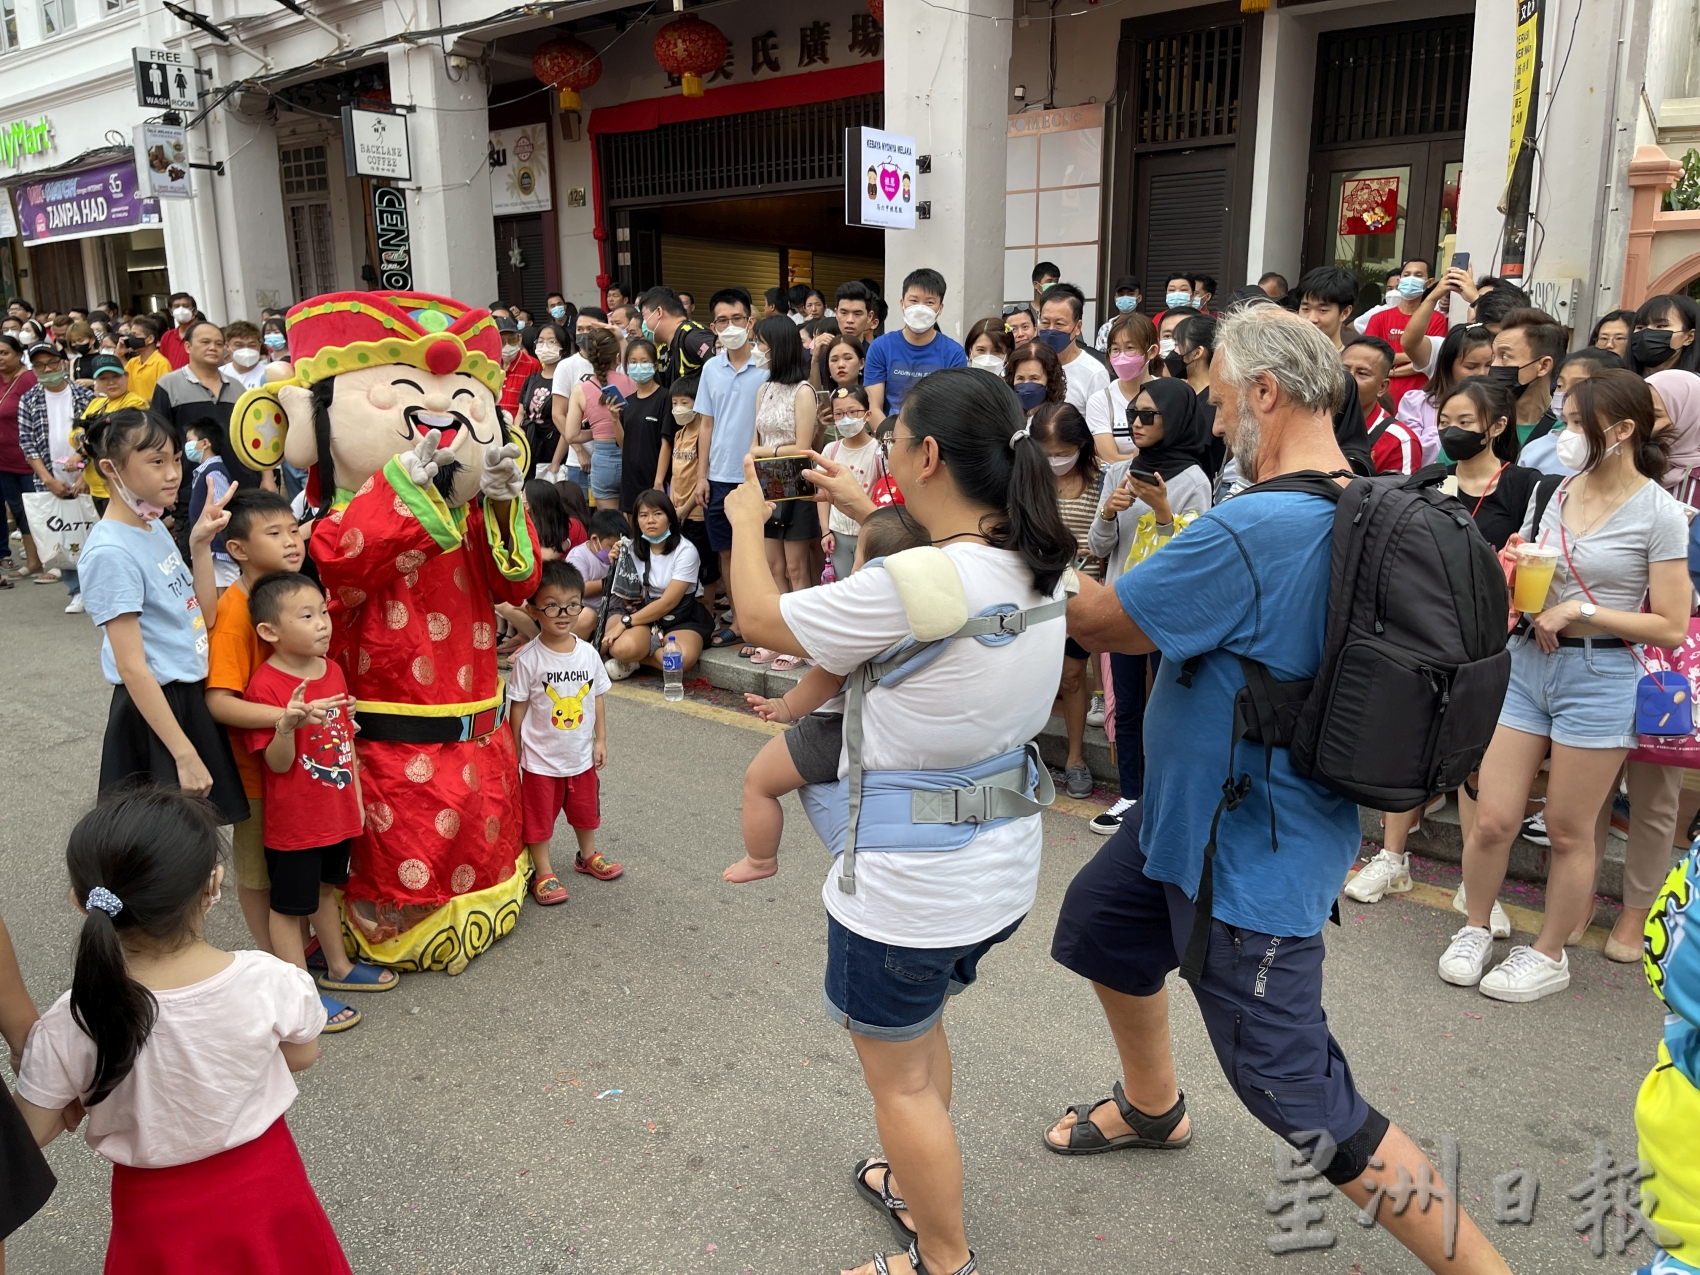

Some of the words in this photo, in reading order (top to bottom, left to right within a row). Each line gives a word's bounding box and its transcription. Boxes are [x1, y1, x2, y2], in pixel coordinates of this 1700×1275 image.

[150, 50, 181, 63] FREE
[146, 96, 170, 106] WASH
[171, 99, 195, 107] ROOM
[360, 143, 402, 157] BACKLANE
[866, 139, 881, 151] KEBAYA
[881, 142, 896, 153] NYONYA
[897, 145, 912, 156] MELAKA
[367, 155, 397, 167] COFFEE
[46, 201, 81, 229] TANPA
[82, 196, 108, 223] HAD
[893, 369, 911, 377] CALVIN
[547, 670, 589, 683] PIKACHU
[341, 740, 351, 754] GO
